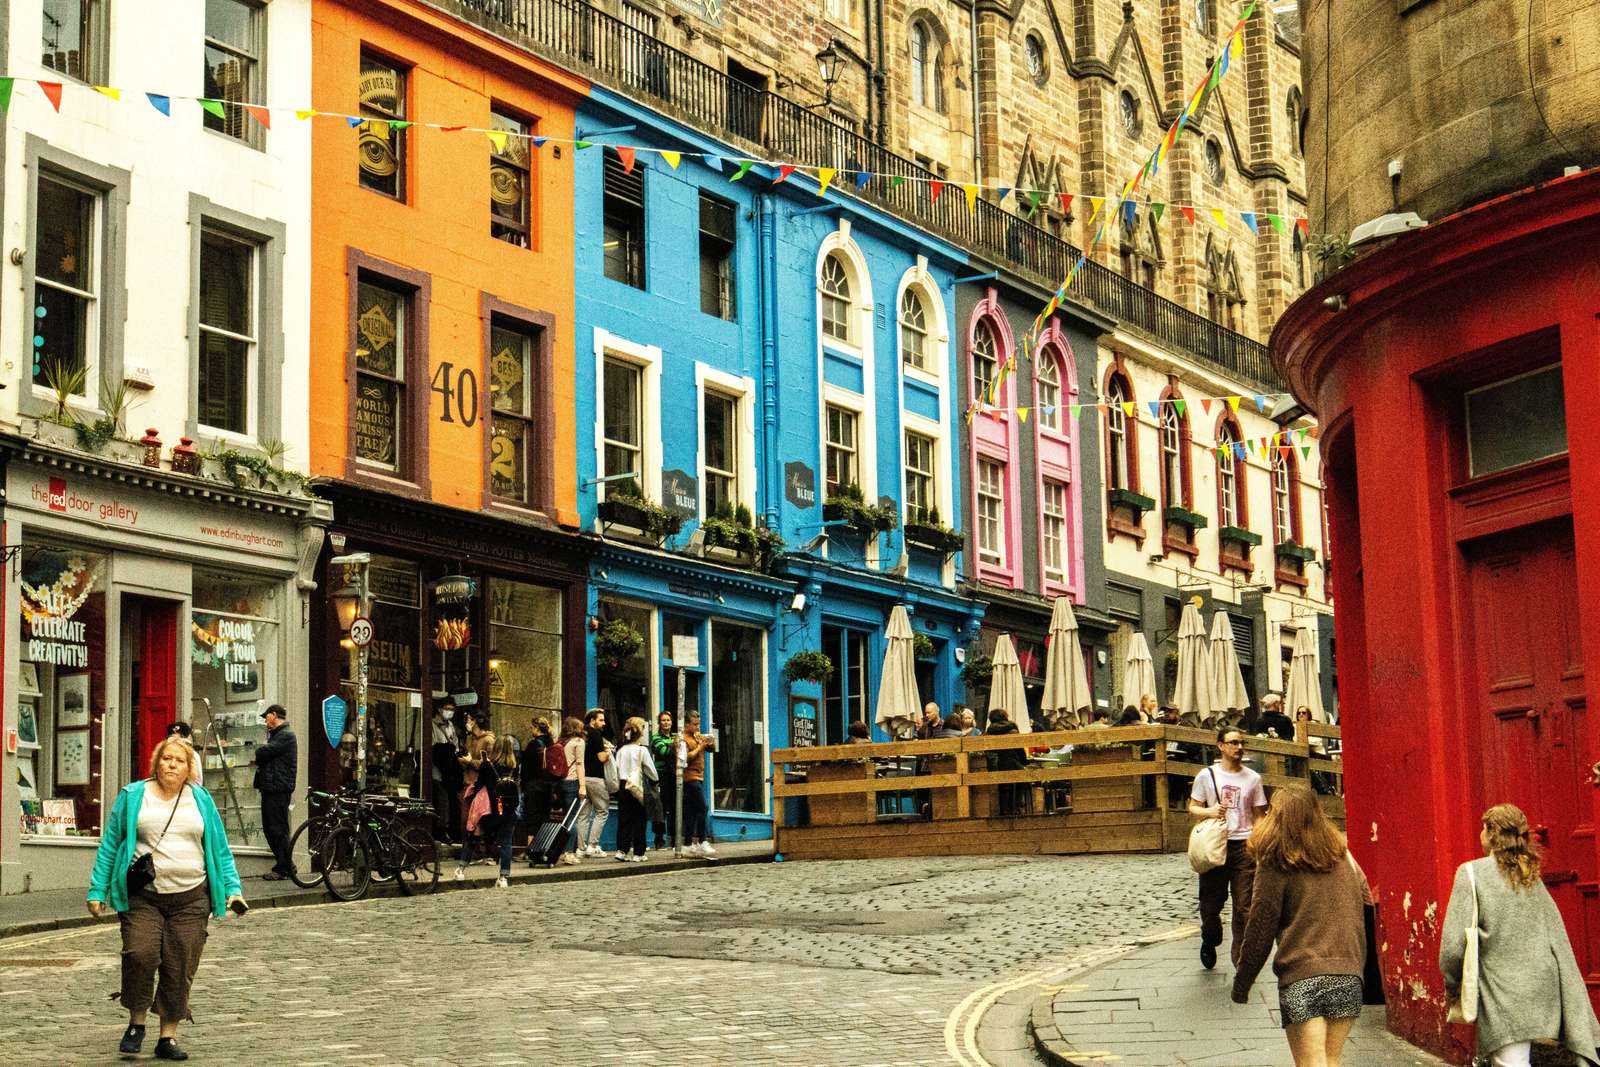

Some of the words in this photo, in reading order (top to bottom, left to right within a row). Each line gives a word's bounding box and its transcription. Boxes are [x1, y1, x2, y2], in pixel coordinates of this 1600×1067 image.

[431, 361, 478, 428] 40
[356, 398, 390, 414] WORLD
[356, 410, 390, 426] AMOUS
[357, 435, 385, 451] FREE
[32, 483, 49, 503] the
[49, 490, 65, 507] red
[68, 491, 94, 513] door
[99, 500, 138, 525] gallery
[675, 495, 696, 511] BLEUE
[796, 487, 815, 502] BLEUE
[200, 525, 284, 548] www.edinburghart.com
[31, 615, 87, 642] CELEBRATE
[29, 639, 89, 668] CREATIVITY!
[217, 640, 229, 660] UP
[233, 642, 258, 664] YOUR
[224, 663, 249, 685] LIFE!
